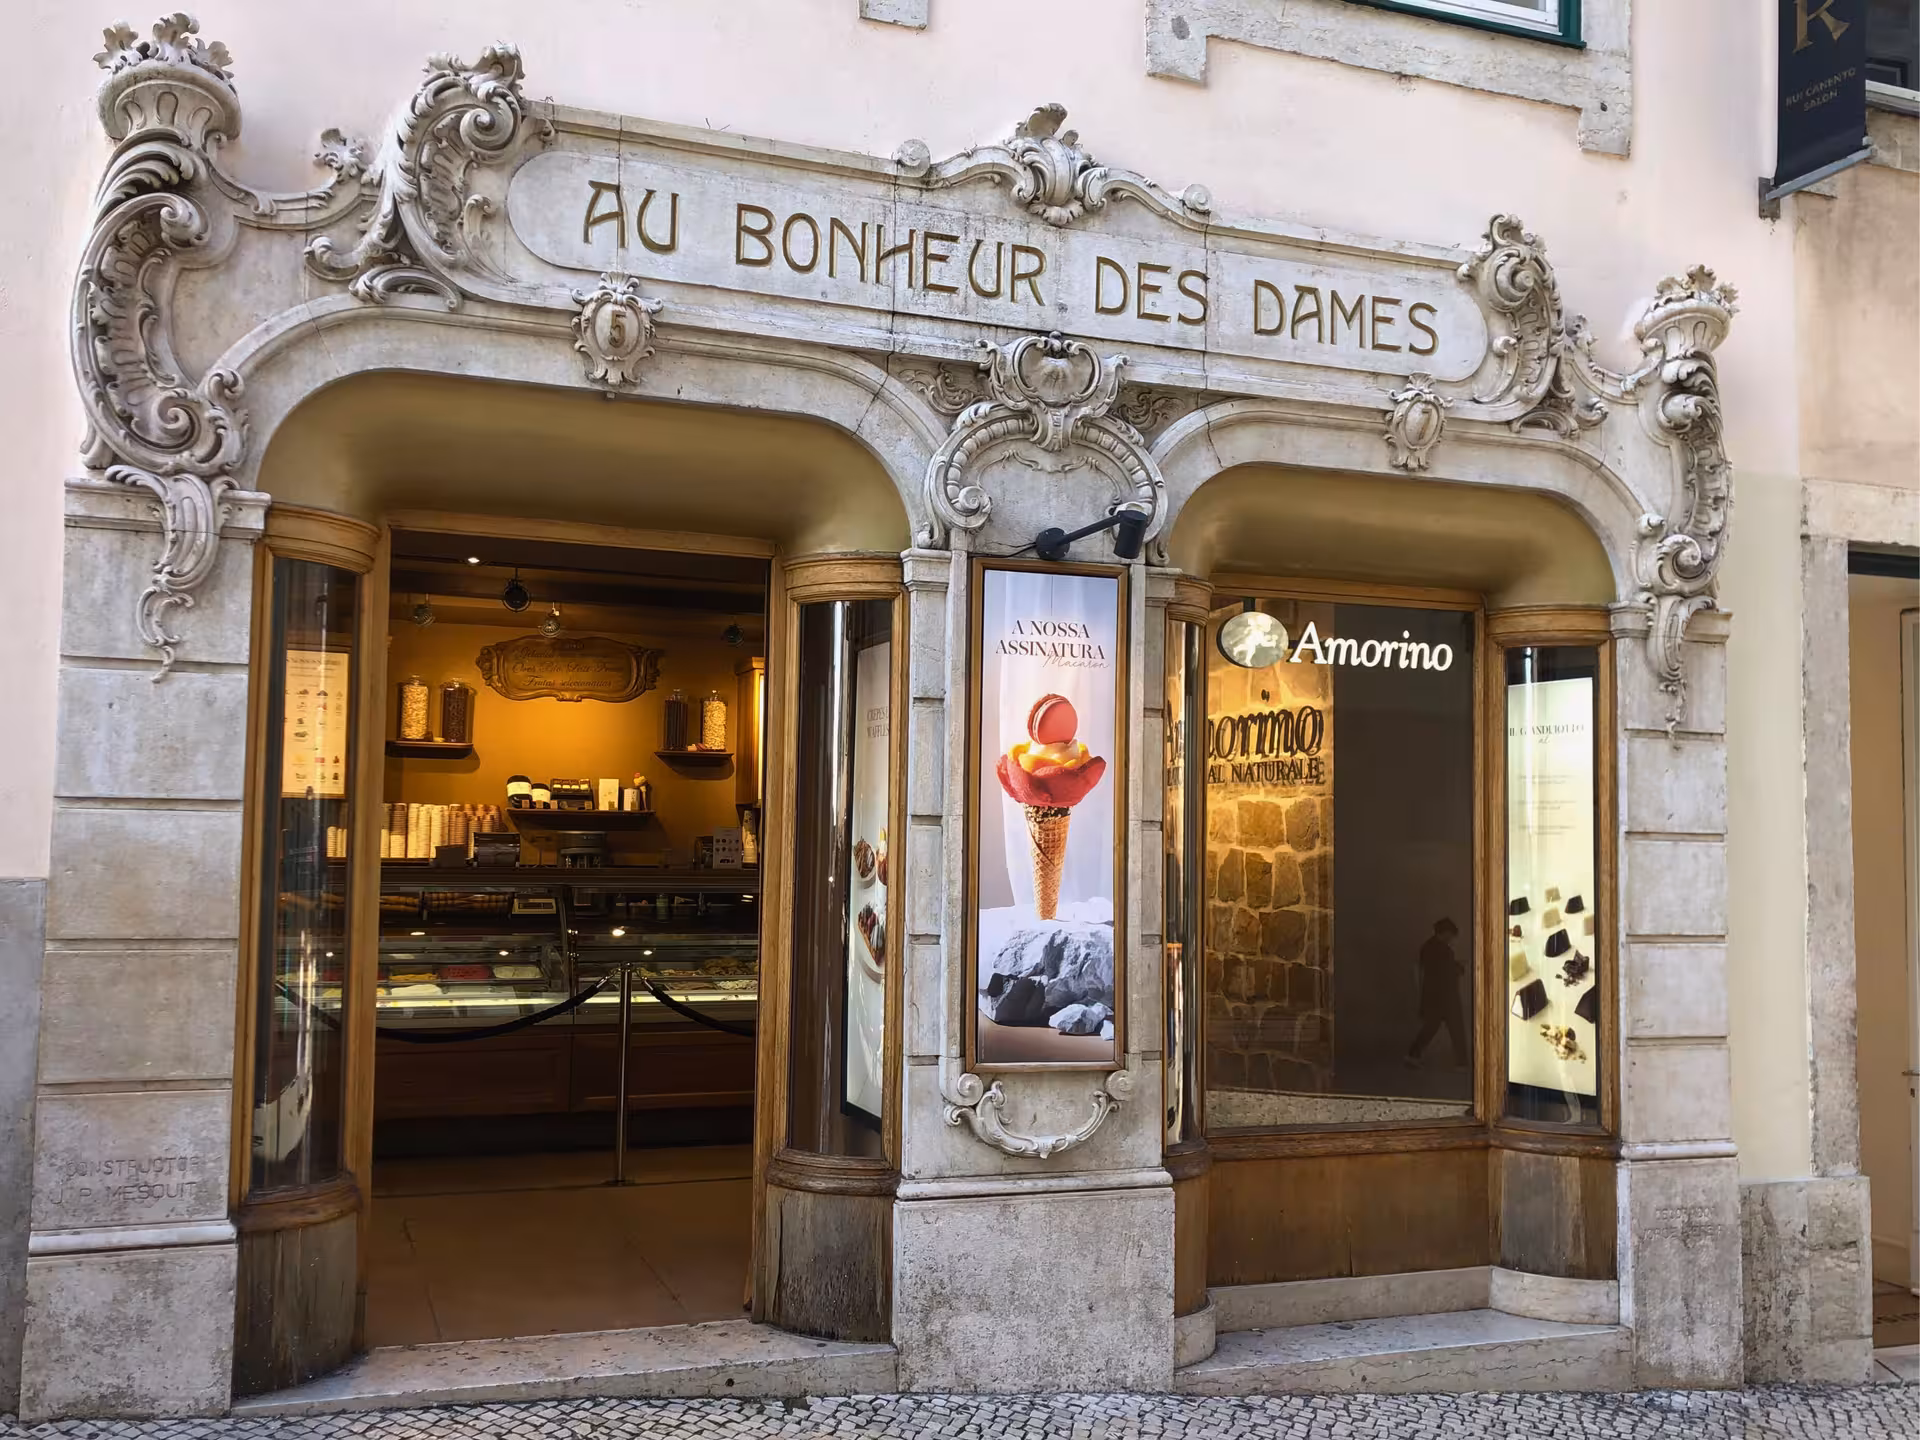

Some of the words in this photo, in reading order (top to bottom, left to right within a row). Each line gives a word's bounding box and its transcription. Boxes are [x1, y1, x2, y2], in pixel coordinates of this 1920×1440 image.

[1803, 89, 1838, 112] SALON
[583, 180, 679, 254] AU
[735, 203, 1047, 306] BONHEUR
[1095, 255, 1210, 326] DES
[1253, 279, 1440, 356] DAMES
[608, 310, 626, 348] 5
[1418, 408, 1433, 441] 7
[1012, 619, 1024, 635] A
[1030, 620, 1090, 639] NOSSA
[995, 639, 1105, 660] ASSINATURA
[1289, 621, 1453, 671] Amorino
[1042, 651, 1110, 669] Macaron
[1231, 757, 1322, 784] NATURALE
